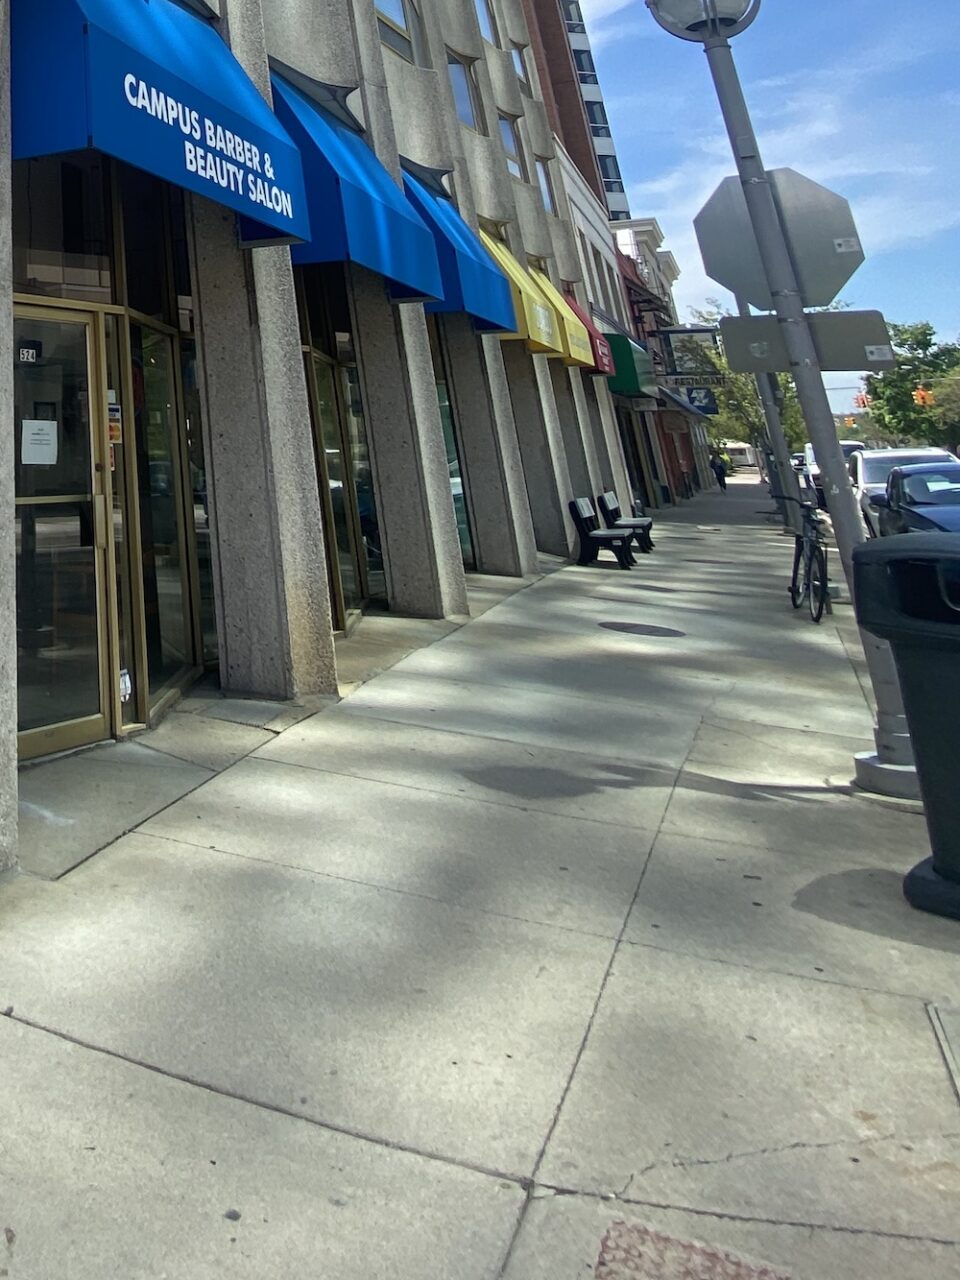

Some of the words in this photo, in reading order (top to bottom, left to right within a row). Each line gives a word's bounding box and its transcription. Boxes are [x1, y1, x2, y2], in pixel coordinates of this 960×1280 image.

[124, 73, 201, 140] CAMPUS
[204, 117, 262, 173] BARBER
[264, 152, 275, 180] &
[184, 140, 244, 195] BEAUTY
[247, 173, 293, 218] SALON
[21, 349, 35, 361] 524
